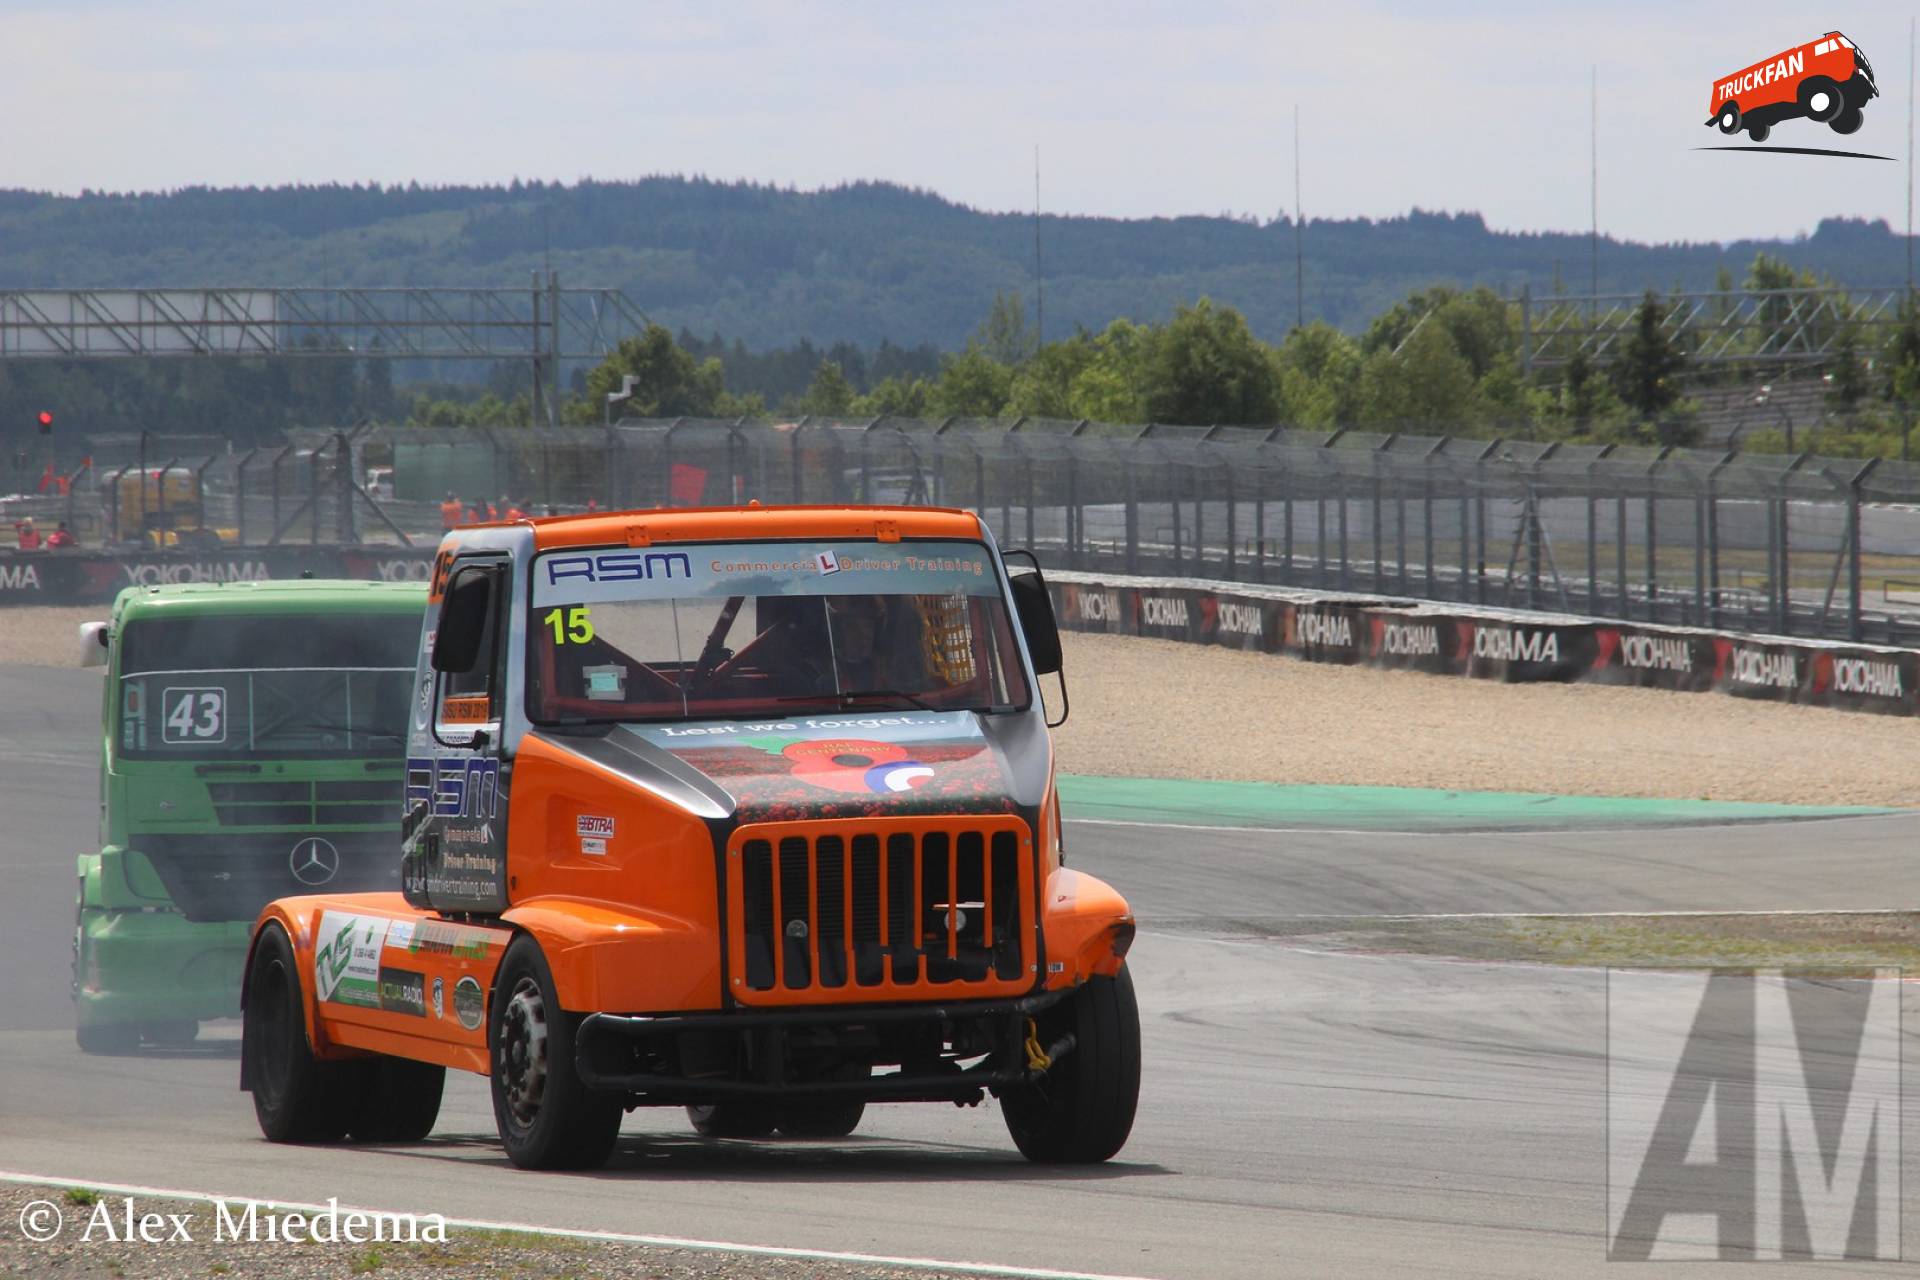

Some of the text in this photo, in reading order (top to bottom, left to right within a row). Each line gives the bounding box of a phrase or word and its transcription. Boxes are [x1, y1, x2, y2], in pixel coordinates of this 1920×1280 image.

[124, 561, 270, 581] YOKOHAMA
[547, 553, 692, 585] RSM
[840, 557, 900, 572] Driver
[905, 556, 983, 576] Training
[544, 607, 595, 645] 15
[1620, 635, 1692, 673] YOKOHAMA
[1732, 646, 1798, 688] YOKOHAMA
[1832, 658, 1902, 697] YOKOHAMA
[167, 693, 222, 738] 43
[660, 725, 738, 738] Lest
[746, 721, 797, 733] we
[404, 757, 499, 819] RSM
[586, 817, 613, 832] BTRA
